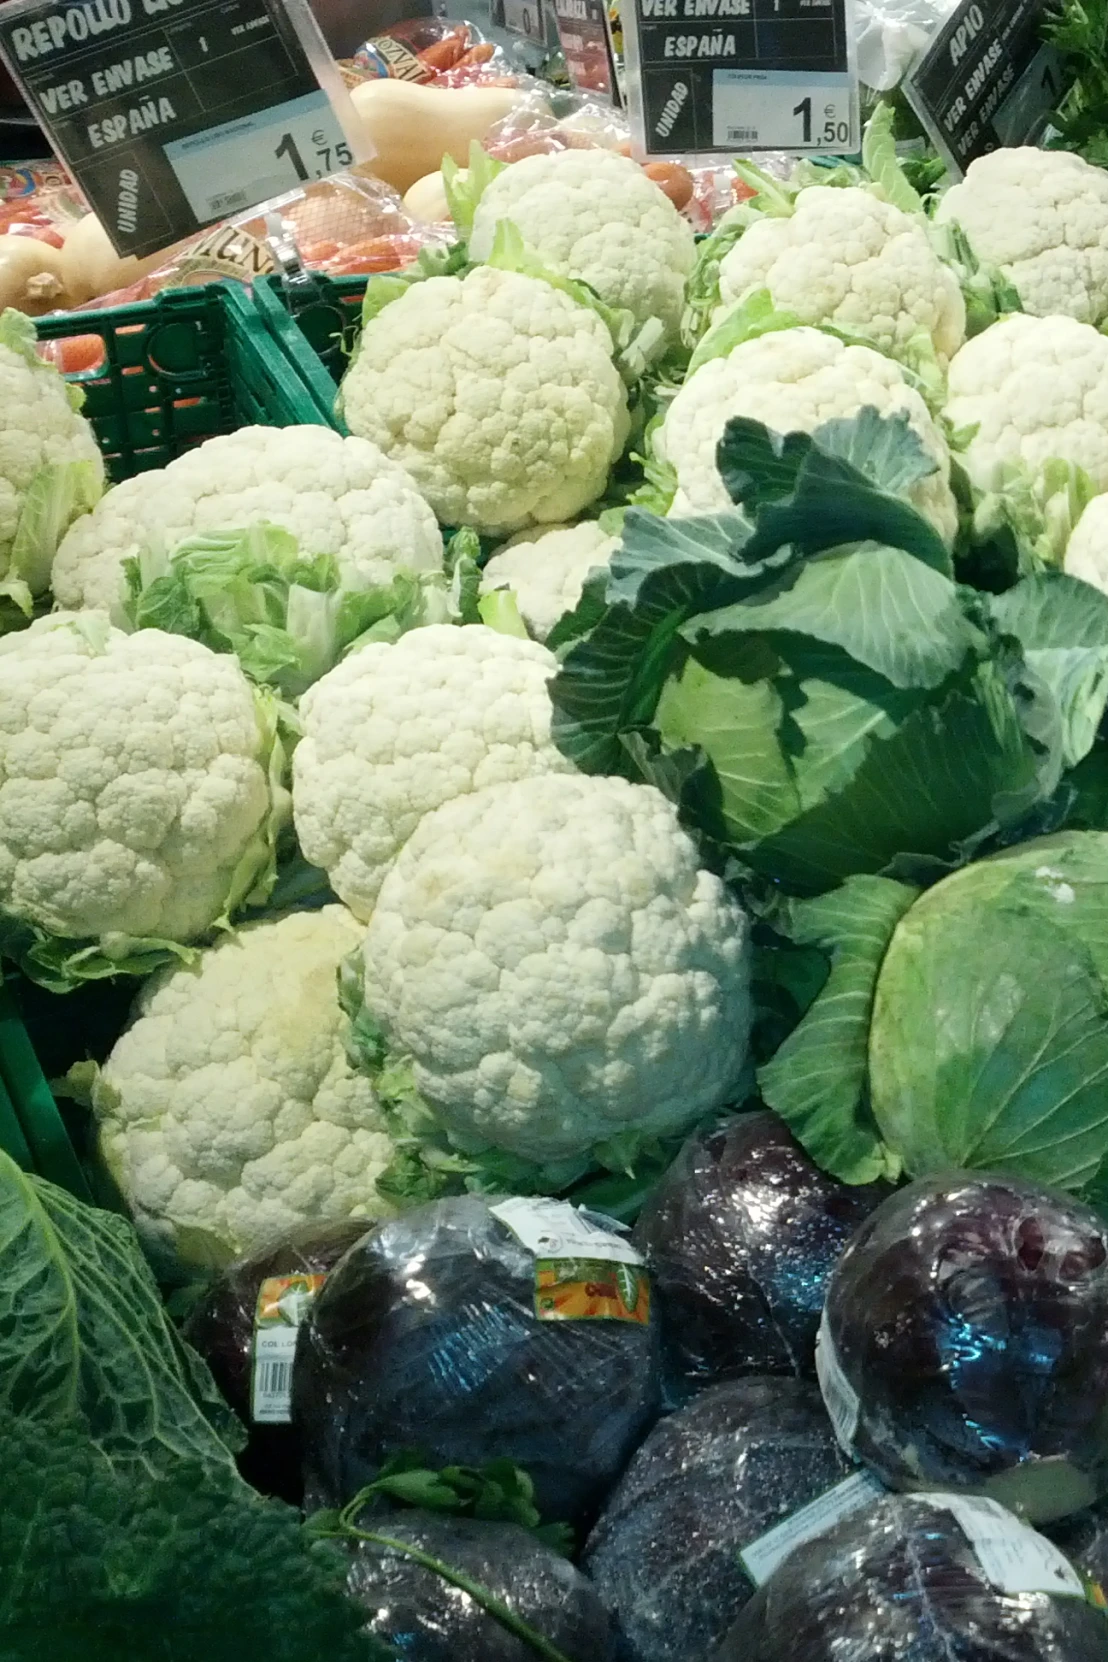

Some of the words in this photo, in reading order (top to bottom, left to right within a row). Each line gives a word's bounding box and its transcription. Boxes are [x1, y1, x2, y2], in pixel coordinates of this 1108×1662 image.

[11, 0, 132, 61] REPOLLO
[642, 0, 677, 16] VER
[950, 4, 984, 67] APIO
[664, 28, 736, 57] ESPAÑA
[39, 79, 89, 114] VER
[91, 46, 174, 96] ENVASE
[655, 81, 688, 137] UNIDAD
[943, 96, 967, 132] VER
[964, 38, 1003, 101] ENVASE
[957, 121, 979, 155] VER
[979, 62, 1014, 124] ENVASE
[87, 95, 177, 149] ESPAÑA
[117, 168, 139, 233] UNIDAD
